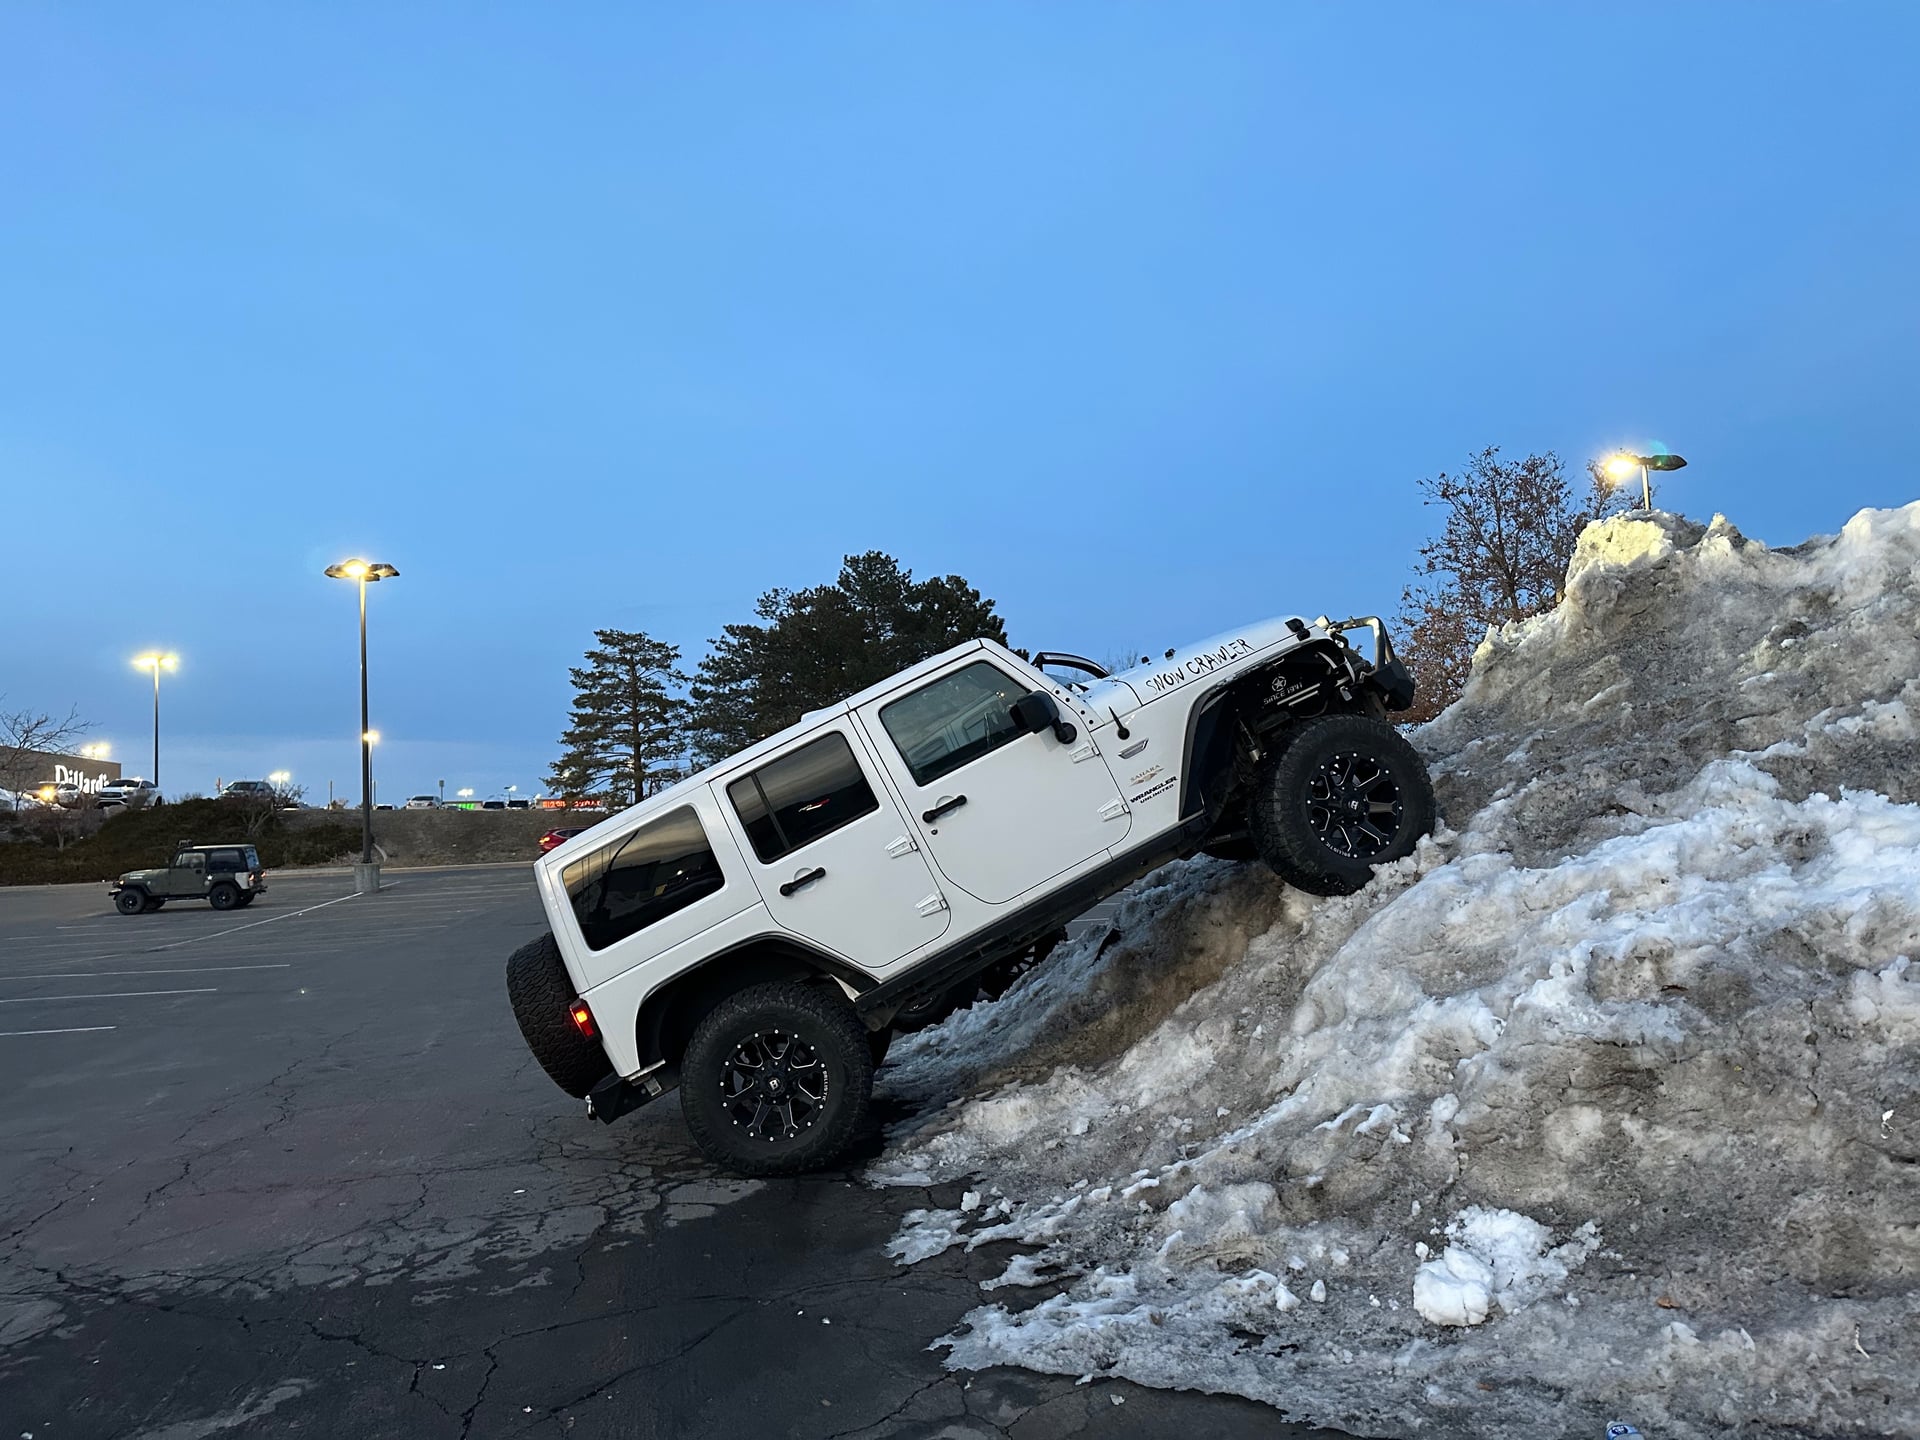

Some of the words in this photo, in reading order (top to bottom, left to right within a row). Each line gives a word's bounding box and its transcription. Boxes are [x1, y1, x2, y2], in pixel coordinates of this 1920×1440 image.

[1145, 666, 1185, 695] SNOW
[1186, 638, 1255, 675] CRAWLER
[1130, 764, 1161, 782] SAHARA
[1130, 776, 1178, 803] WRANGLER
[1140, 783, 1174, 804] UNLIMITED
